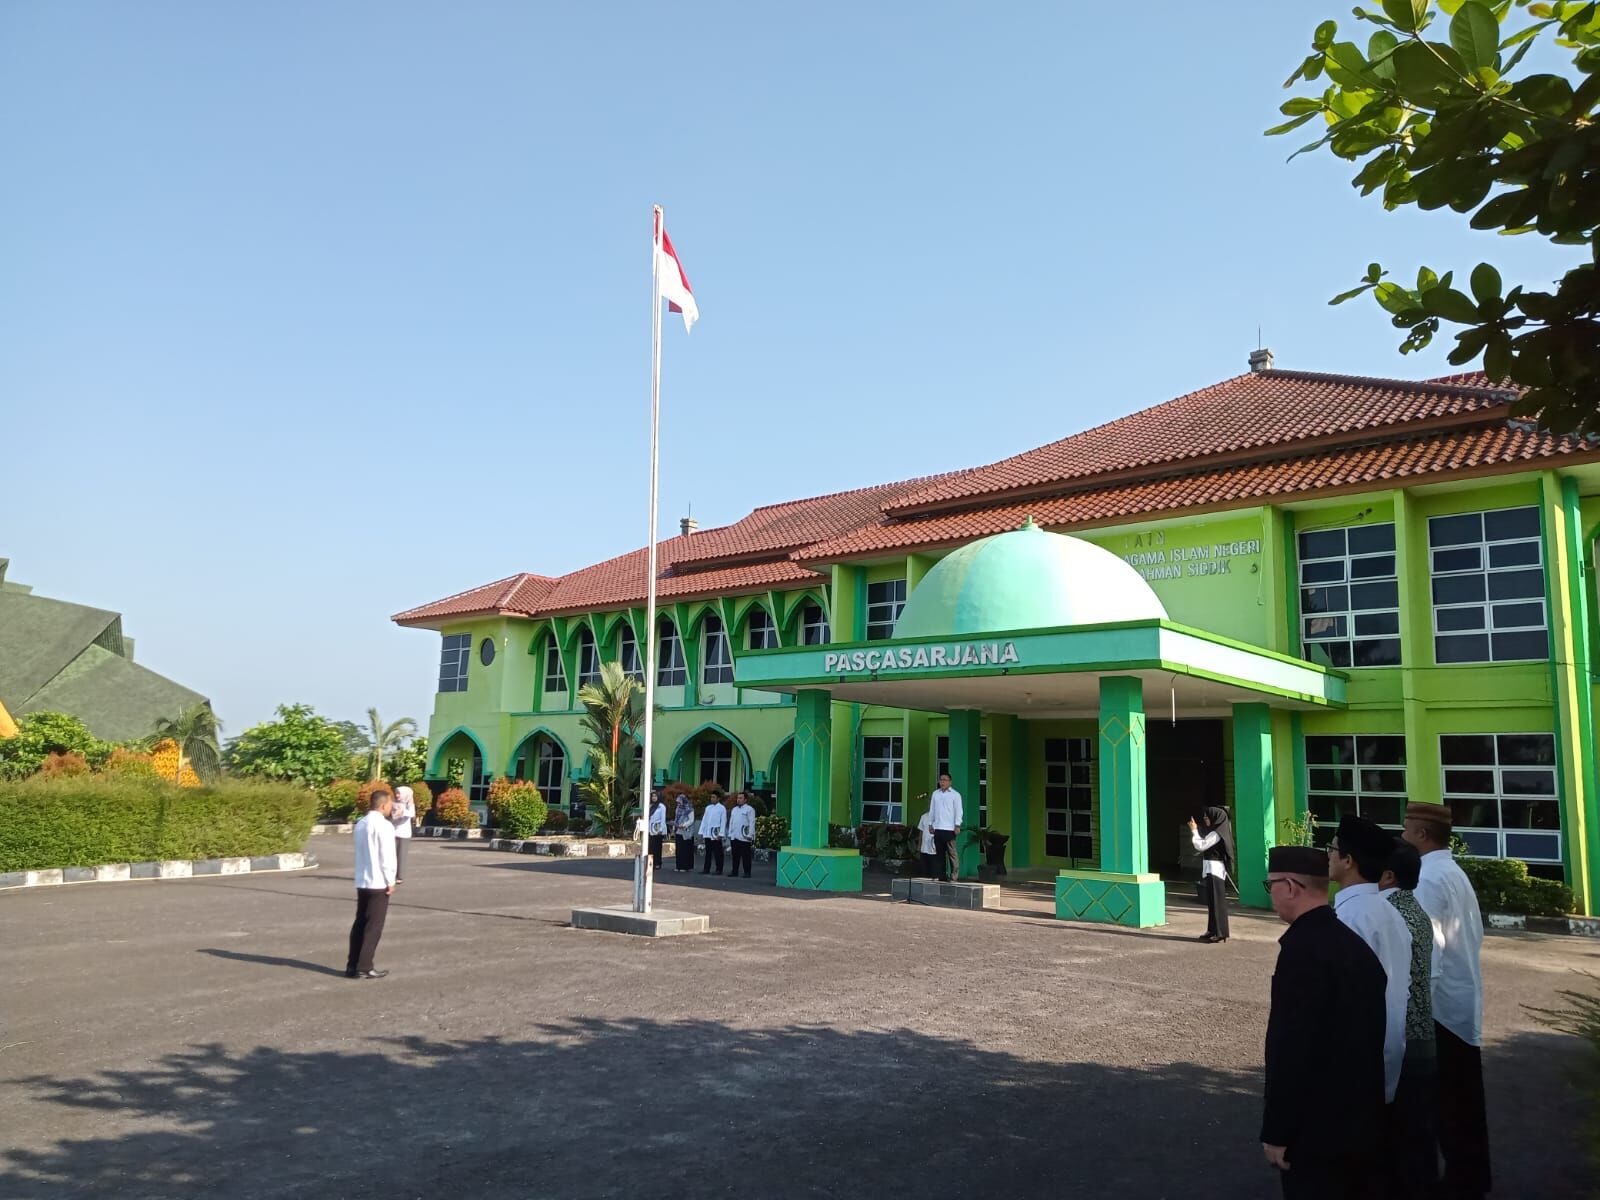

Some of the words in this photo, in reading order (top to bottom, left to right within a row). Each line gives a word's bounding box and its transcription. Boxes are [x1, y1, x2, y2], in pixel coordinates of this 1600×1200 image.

[1124, 552, 1165, 566] AGAMA
[1170, 546, 1209, 561] ISLAM
[1214, 539, 1260, 557] NEGERI
[1187, 560, 1231, 576] SIDDIK
[825, 643, 1019, 672] PASCASARJANA
